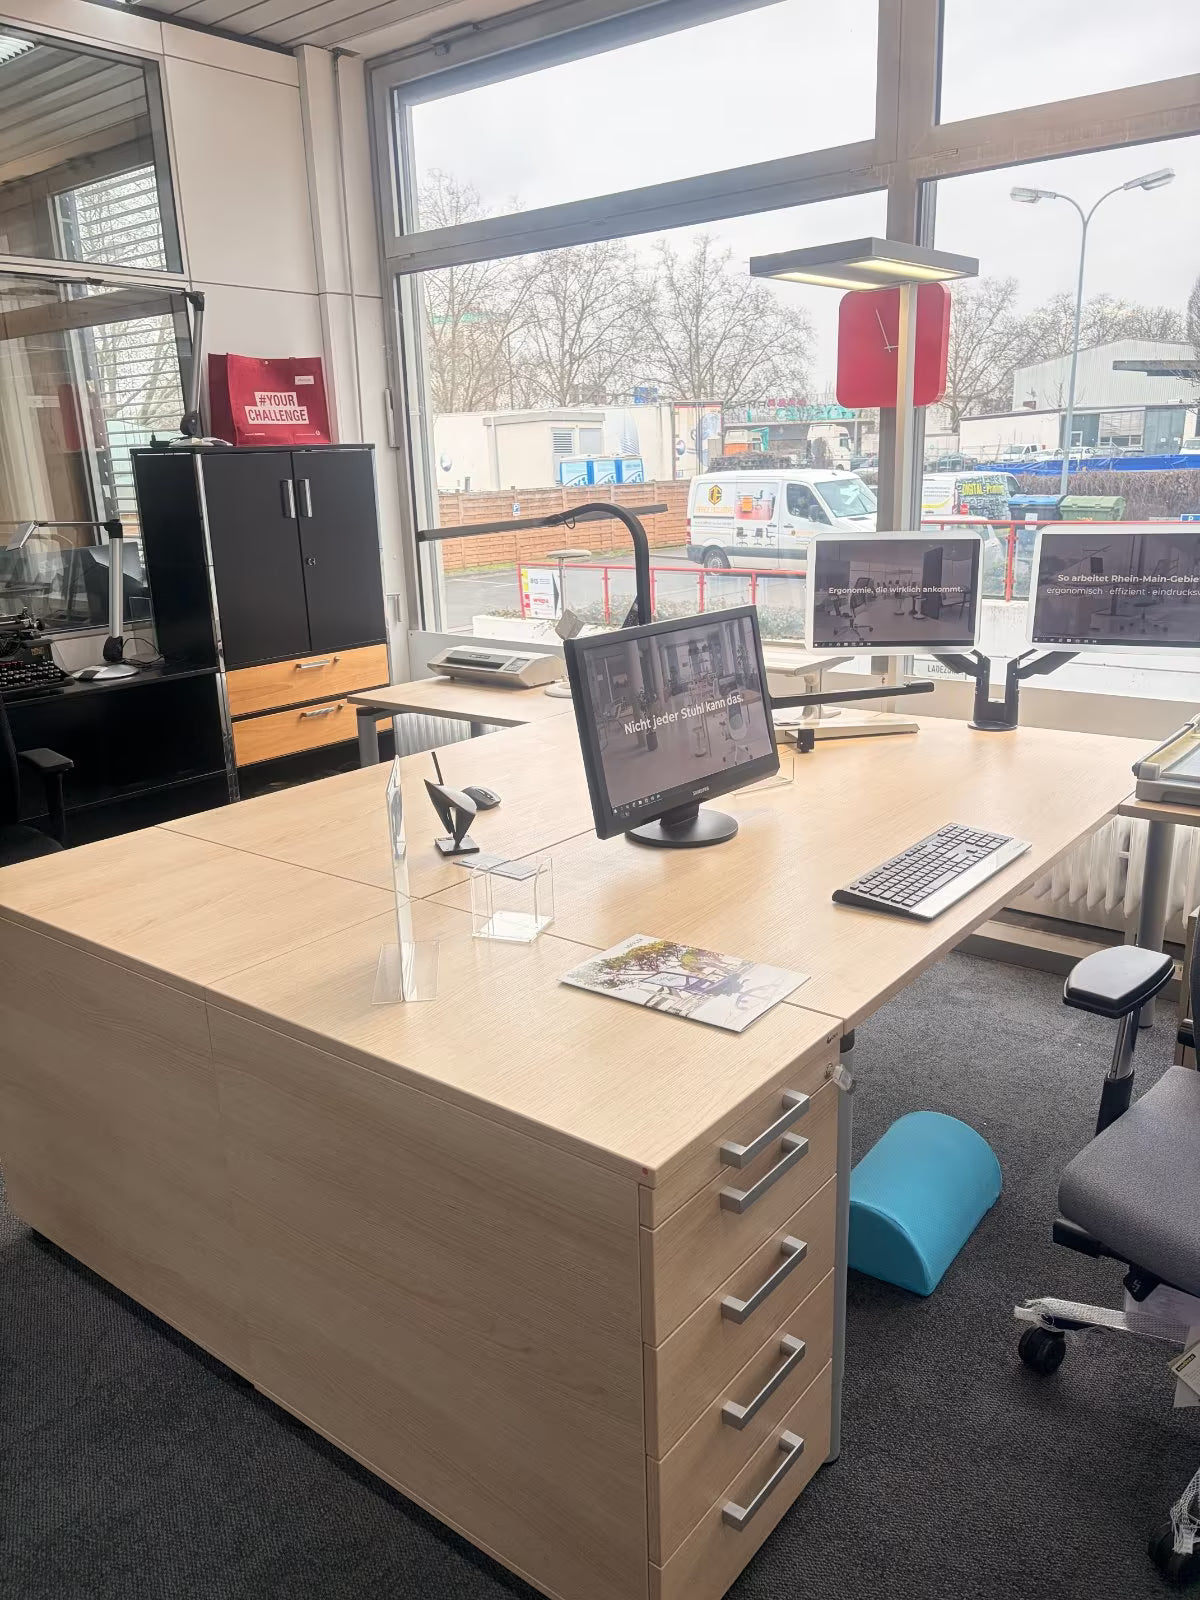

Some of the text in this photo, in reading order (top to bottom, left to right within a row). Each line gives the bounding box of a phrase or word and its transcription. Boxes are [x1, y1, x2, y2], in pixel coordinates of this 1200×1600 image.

[258, 394, 295, 406] #YOUR
[248, 409, 307, 421] CHALLENGE
[1057, 574, 1200, 583] So arbeitet Rhein-Main-Gebie
[828, 587, 874, 595] Ergonomie,
[1046, 587, 1103, 596] ergonomisch
[1109, 587, 1146, 596] effizient
[624, 694, 744, 735] Nicht jeder Stuhl kann das.
